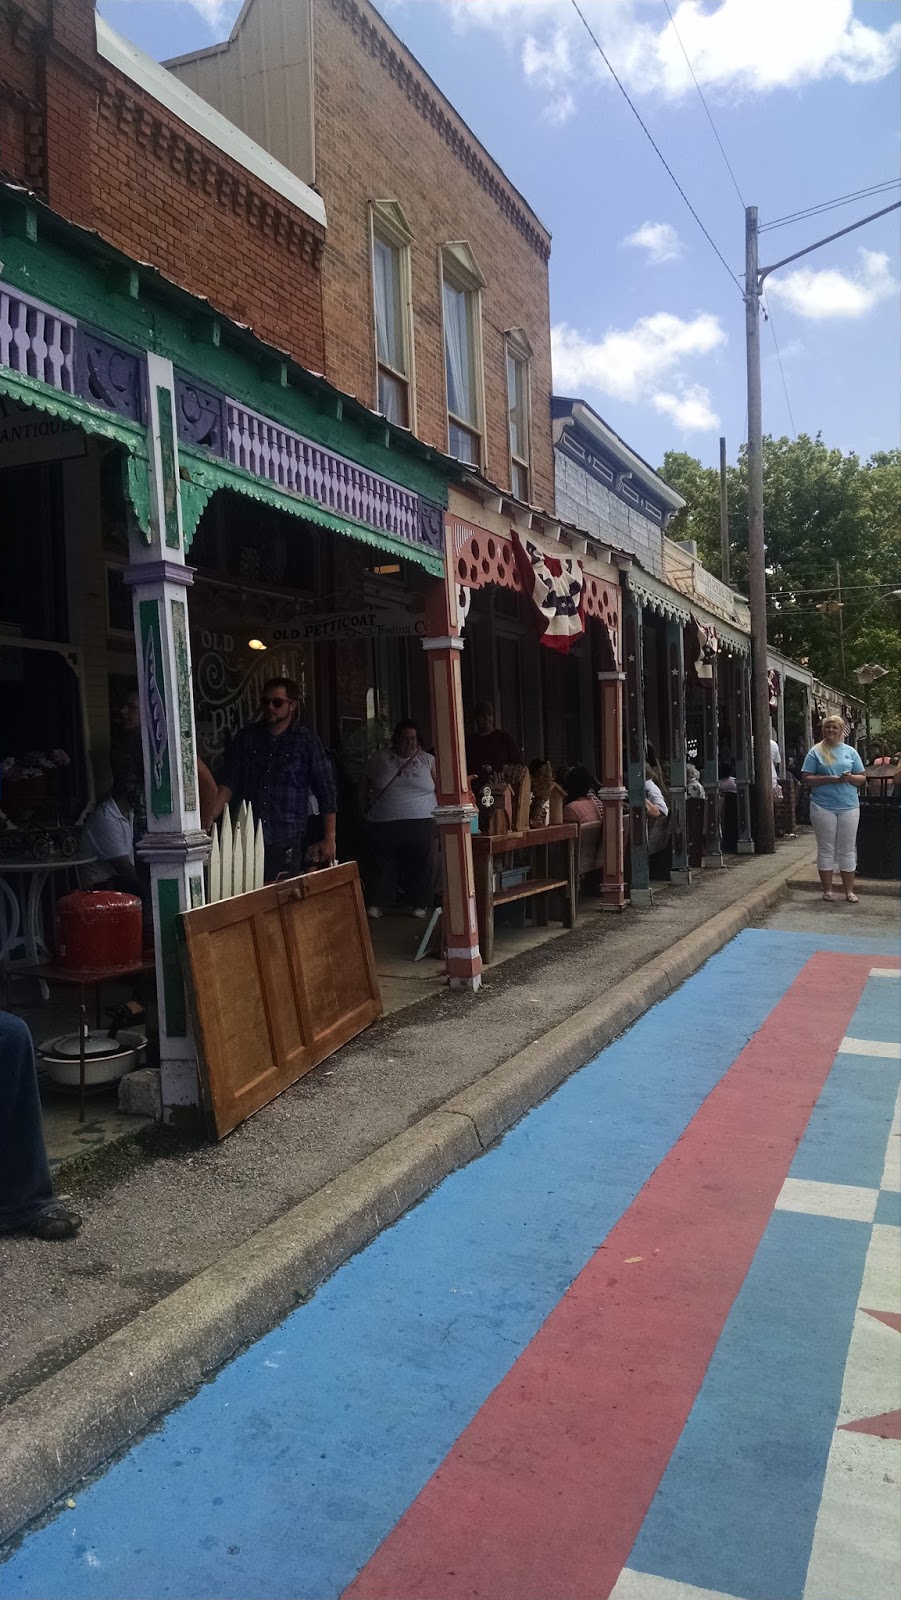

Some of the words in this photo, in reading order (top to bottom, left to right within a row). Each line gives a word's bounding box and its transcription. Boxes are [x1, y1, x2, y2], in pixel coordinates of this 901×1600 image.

[273, 629, 300, 641] OLD
[304, 614, 377, 638] PETTICOAT
[375, 624, 411, 635] Trading
[202, 630, 234, 651] OLD
